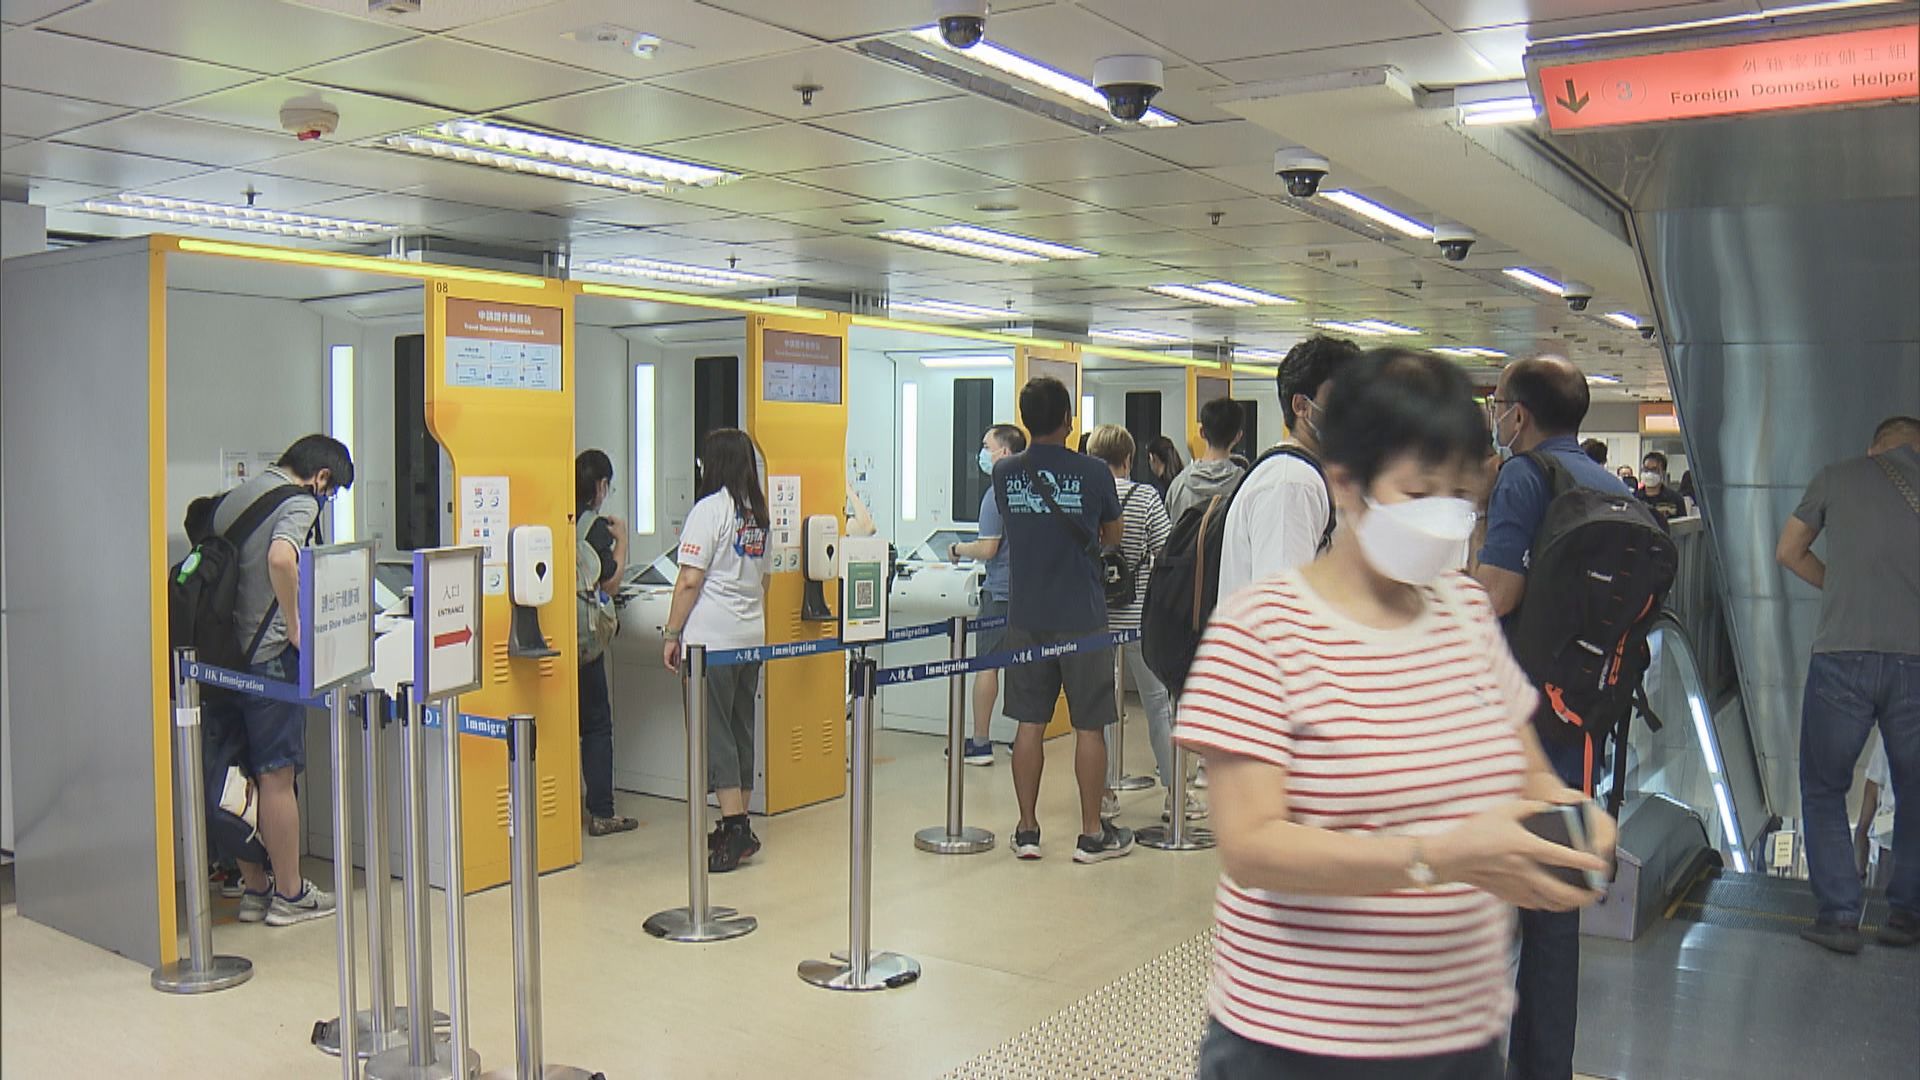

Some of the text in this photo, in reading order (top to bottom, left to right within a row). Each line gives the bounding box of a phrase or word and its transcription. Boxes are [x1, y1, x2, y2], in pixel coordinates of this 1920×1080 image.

[1616, 81, 1633, 100] 3
[1671, 70, 1916, 106] Foreign Domestic Helper
[436, 282, 448, 293] 08
[1006, 480, 1080, 493] 20 18
[442, 584, 460, 600] 入口
[437, 604, 464, 617] ENTRANCE
[329, 619, 342, 631] Show
[892, 626, 930, 640] Immigration
[772, 642, 817, 656] Immigration
[1041, 642, 1078, 657] Immigration
[925, 660, 969, 675] Immigration
[204, 668, 264, 692] HK Immigration
[465, 716, 507, 735] Immigra
